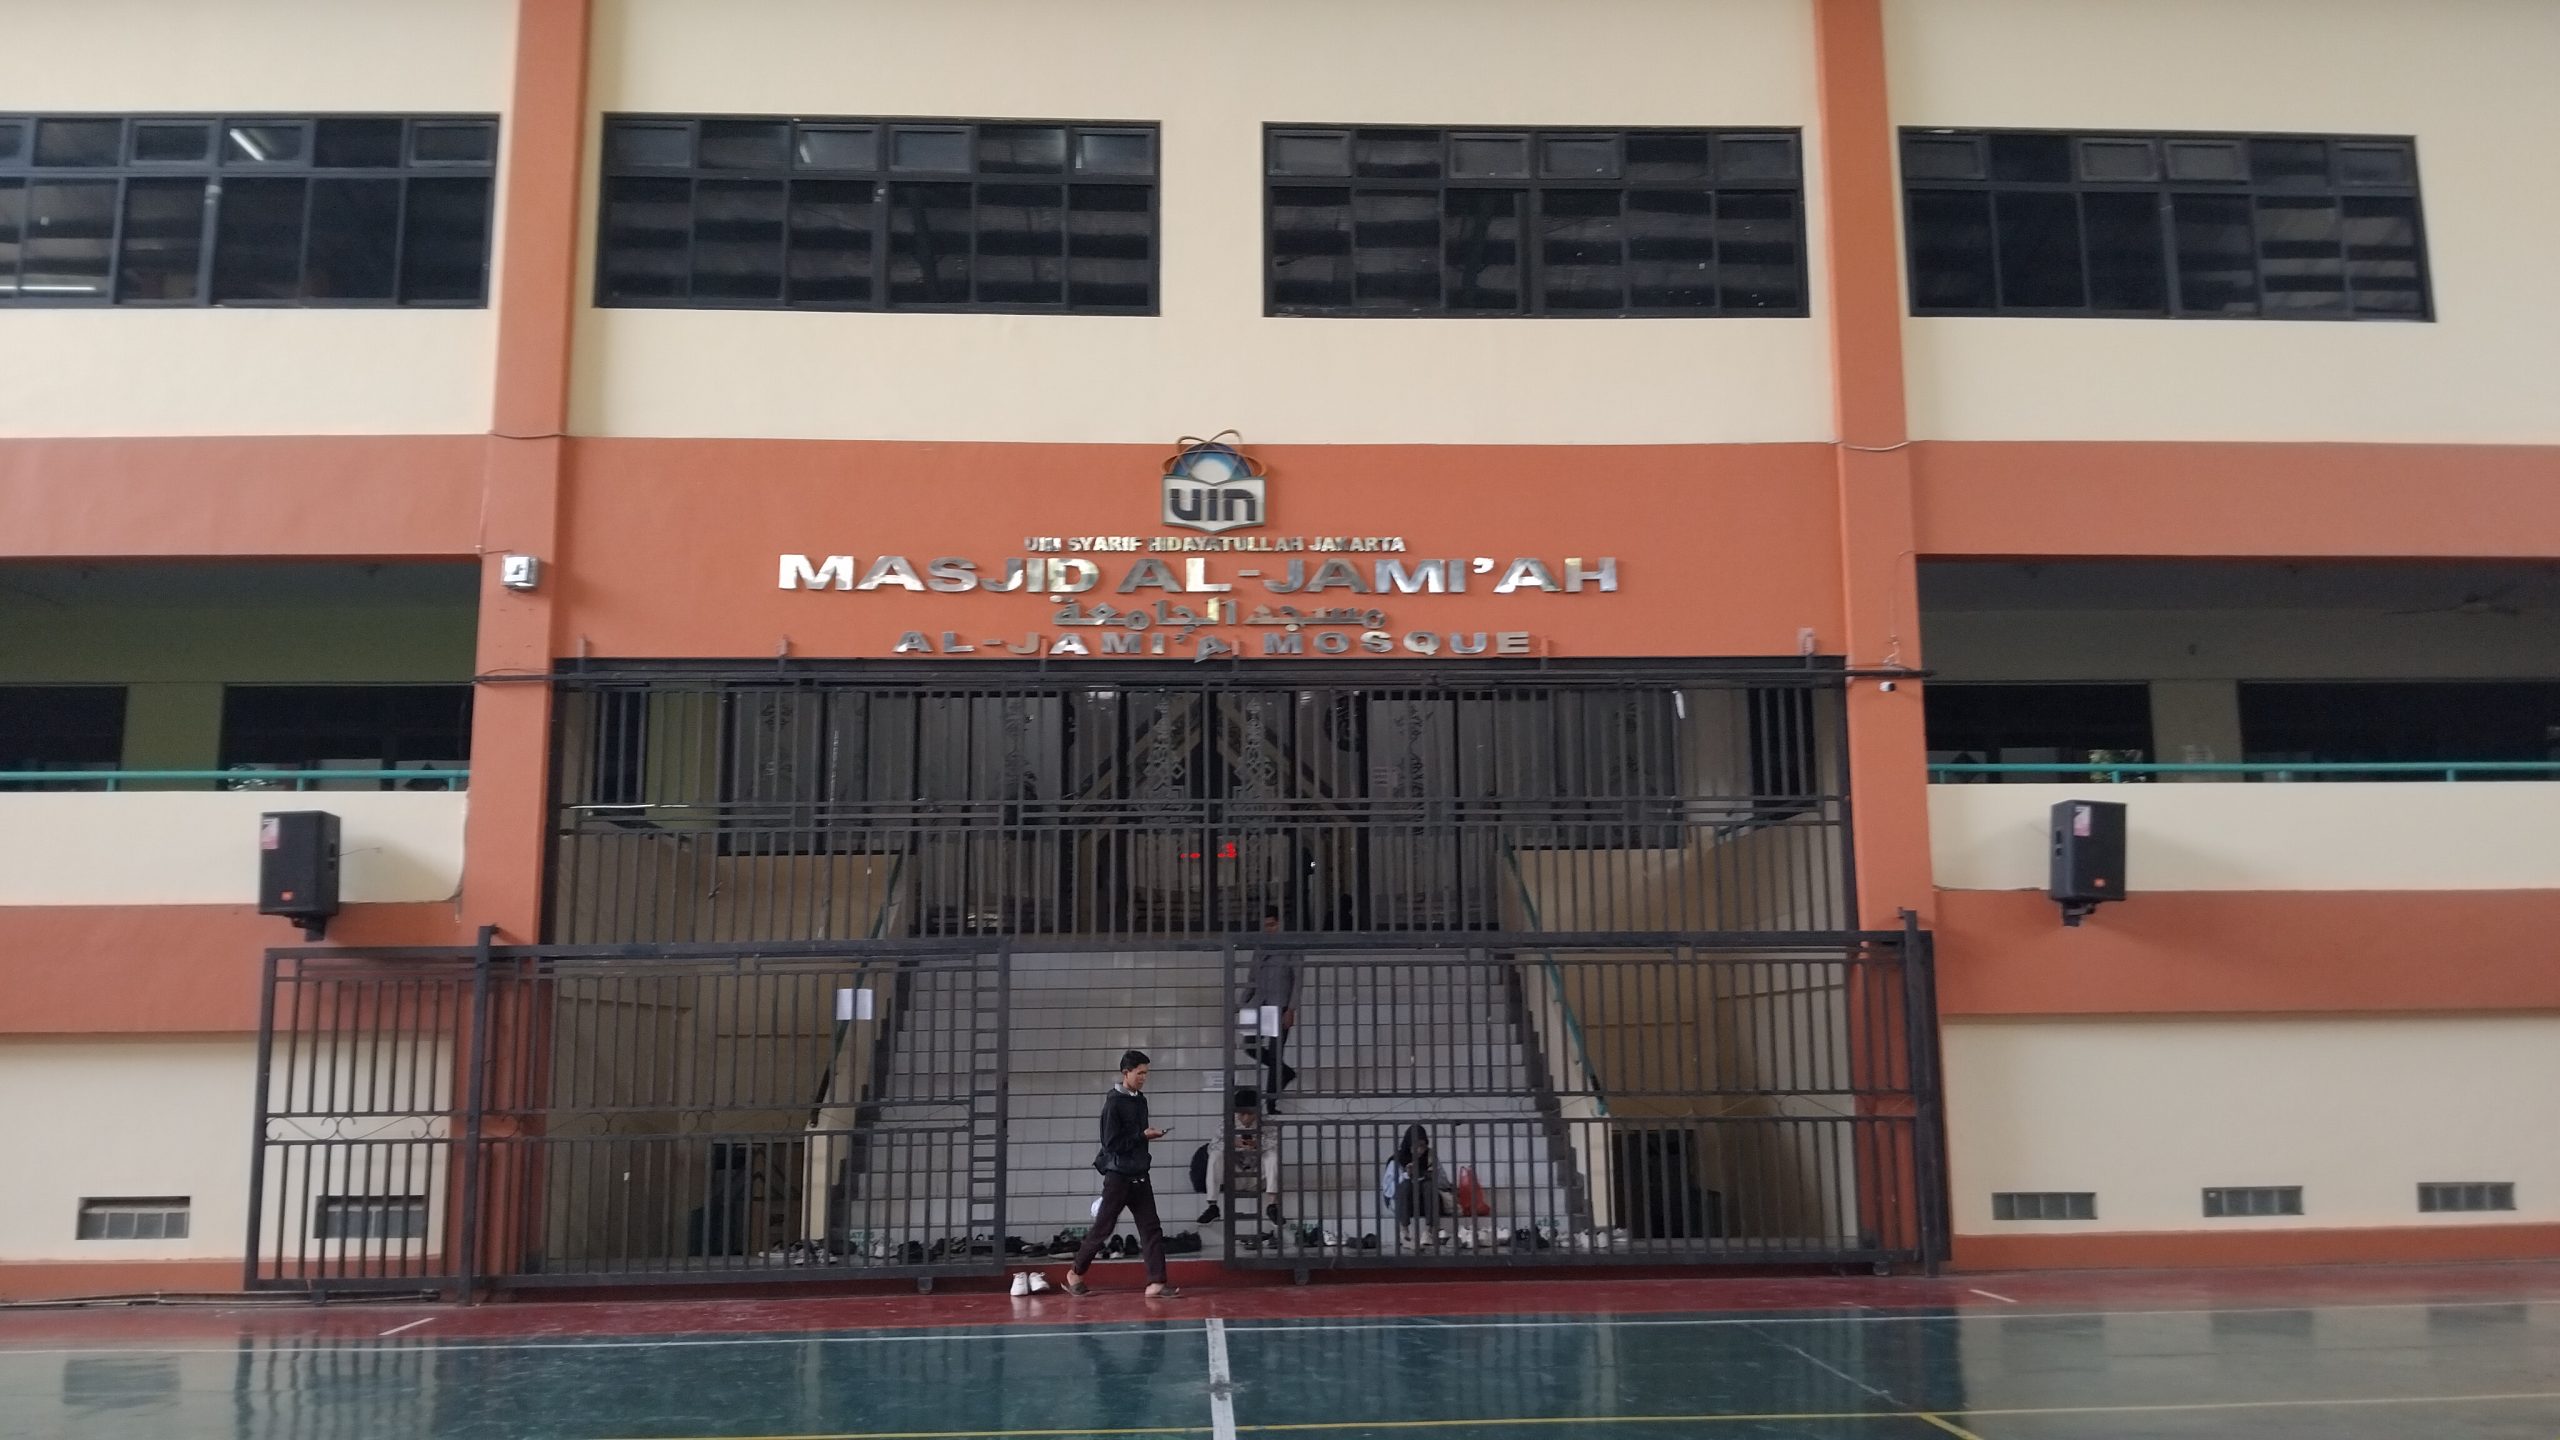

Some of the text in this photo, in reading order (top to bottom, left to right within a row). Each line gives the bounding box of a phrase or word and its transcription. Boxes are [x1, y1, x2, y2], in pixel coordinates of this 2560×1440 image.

[1024, 536, 1406, 553] UIN SYARIF HIDAYATULLAH JAKARTA
[778, 554, 1100, 594] MASJID
[1263, 631, 1530, 656] MOSQUE
